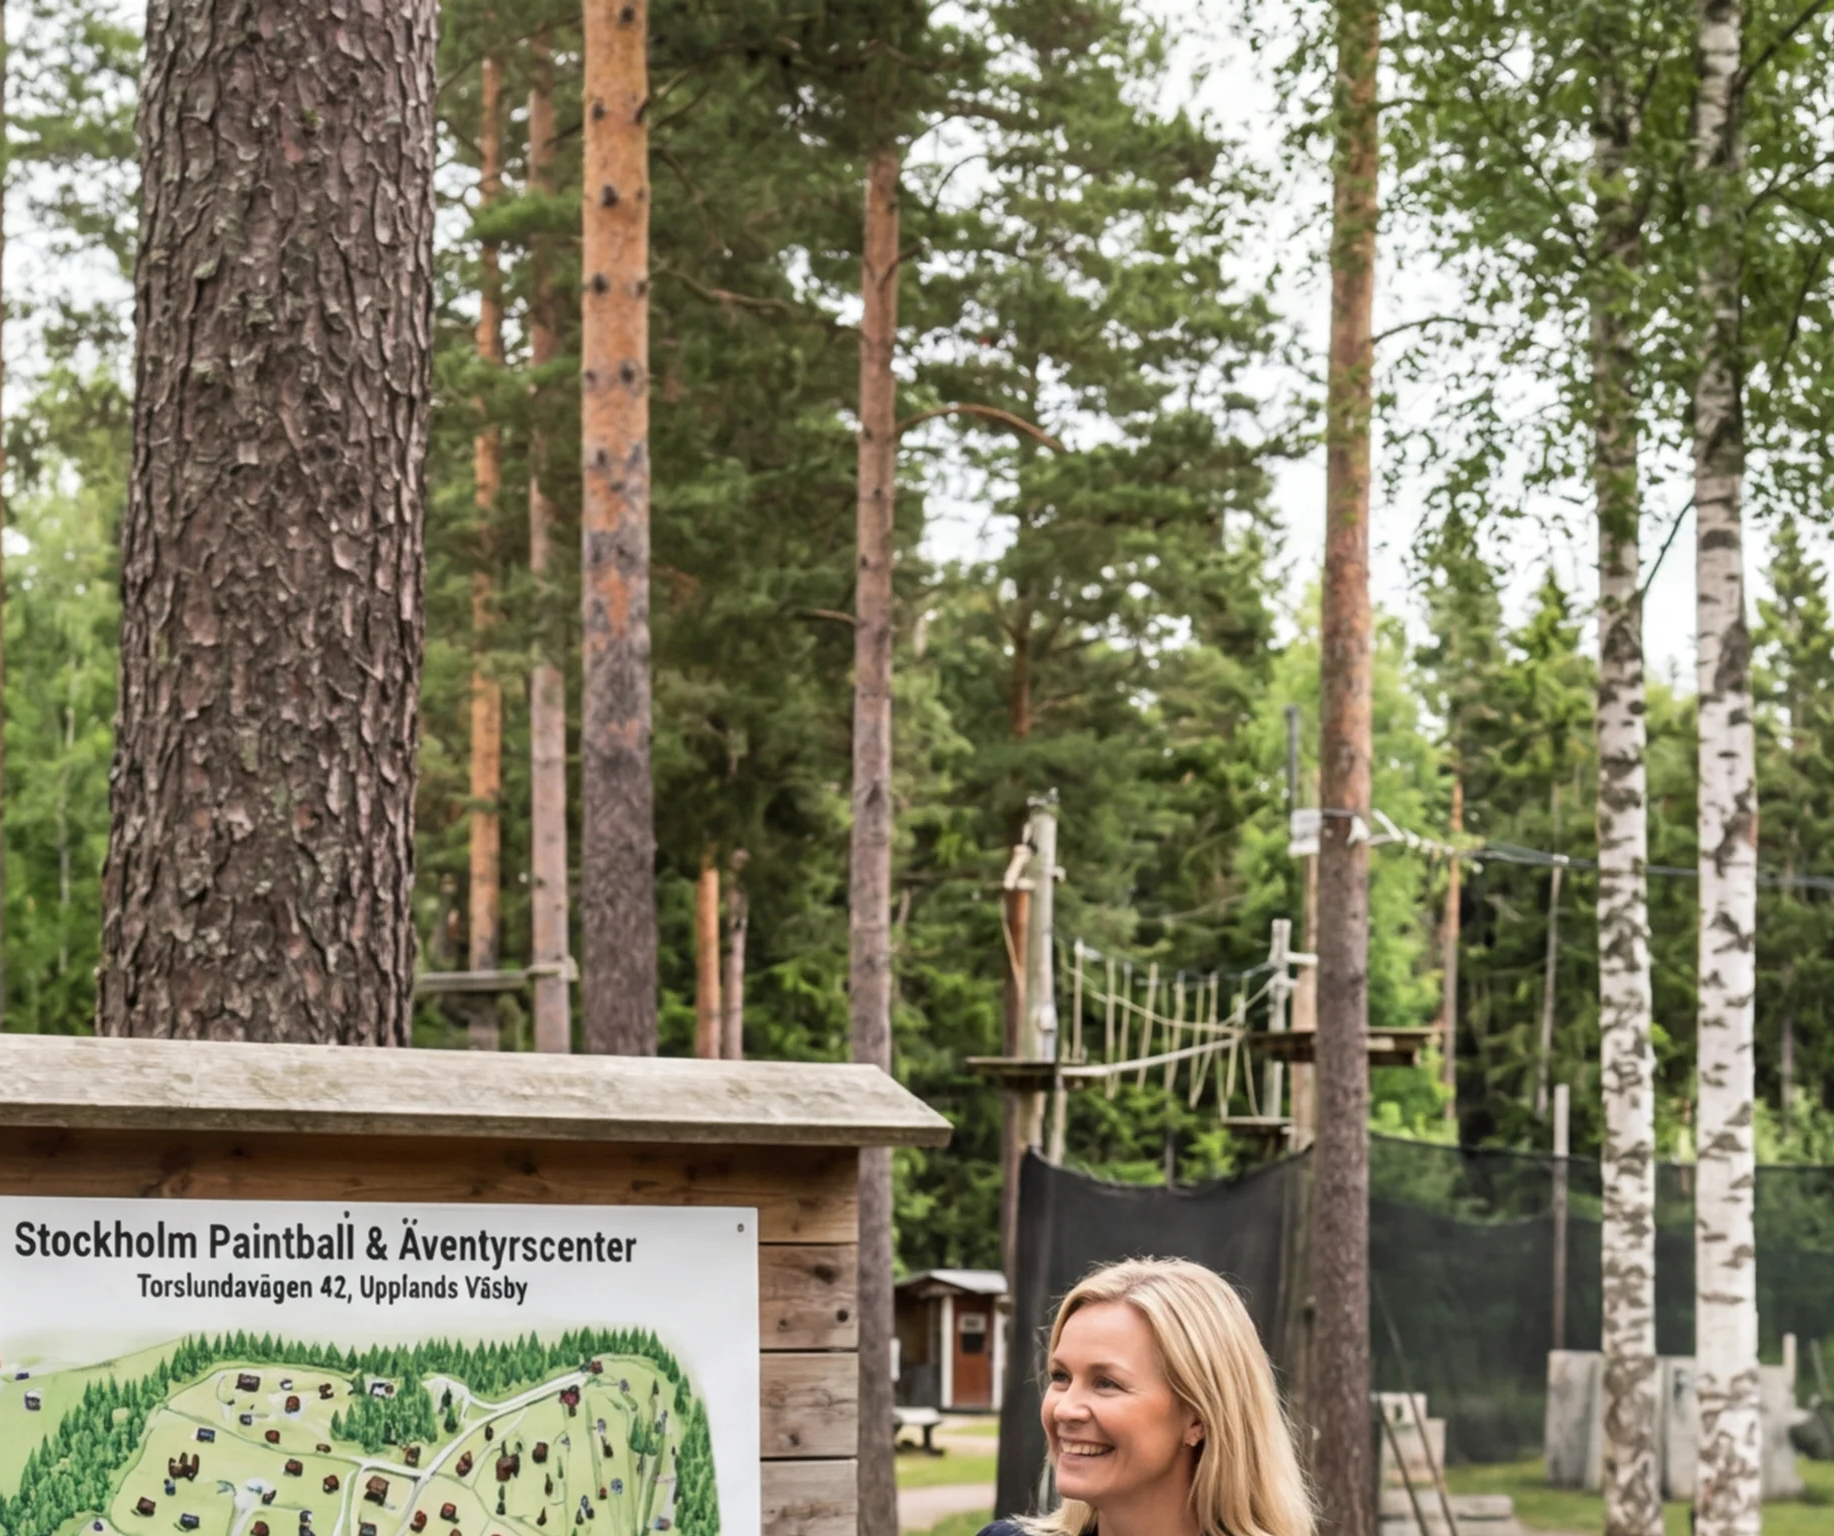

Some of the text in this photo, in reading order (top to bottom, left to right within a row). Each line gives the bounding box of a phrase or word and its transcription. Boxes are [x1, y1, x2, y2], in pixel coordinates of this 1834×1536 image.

[15, 1219, 197, 1259] Stockholm
[365, 1225, 388, 1261] &
[398, 1217, 637, 1271] Äventyrscenter
[319, 1274, 353, 1304] 42,
[360, 1273, 459, 1306] Upplands
